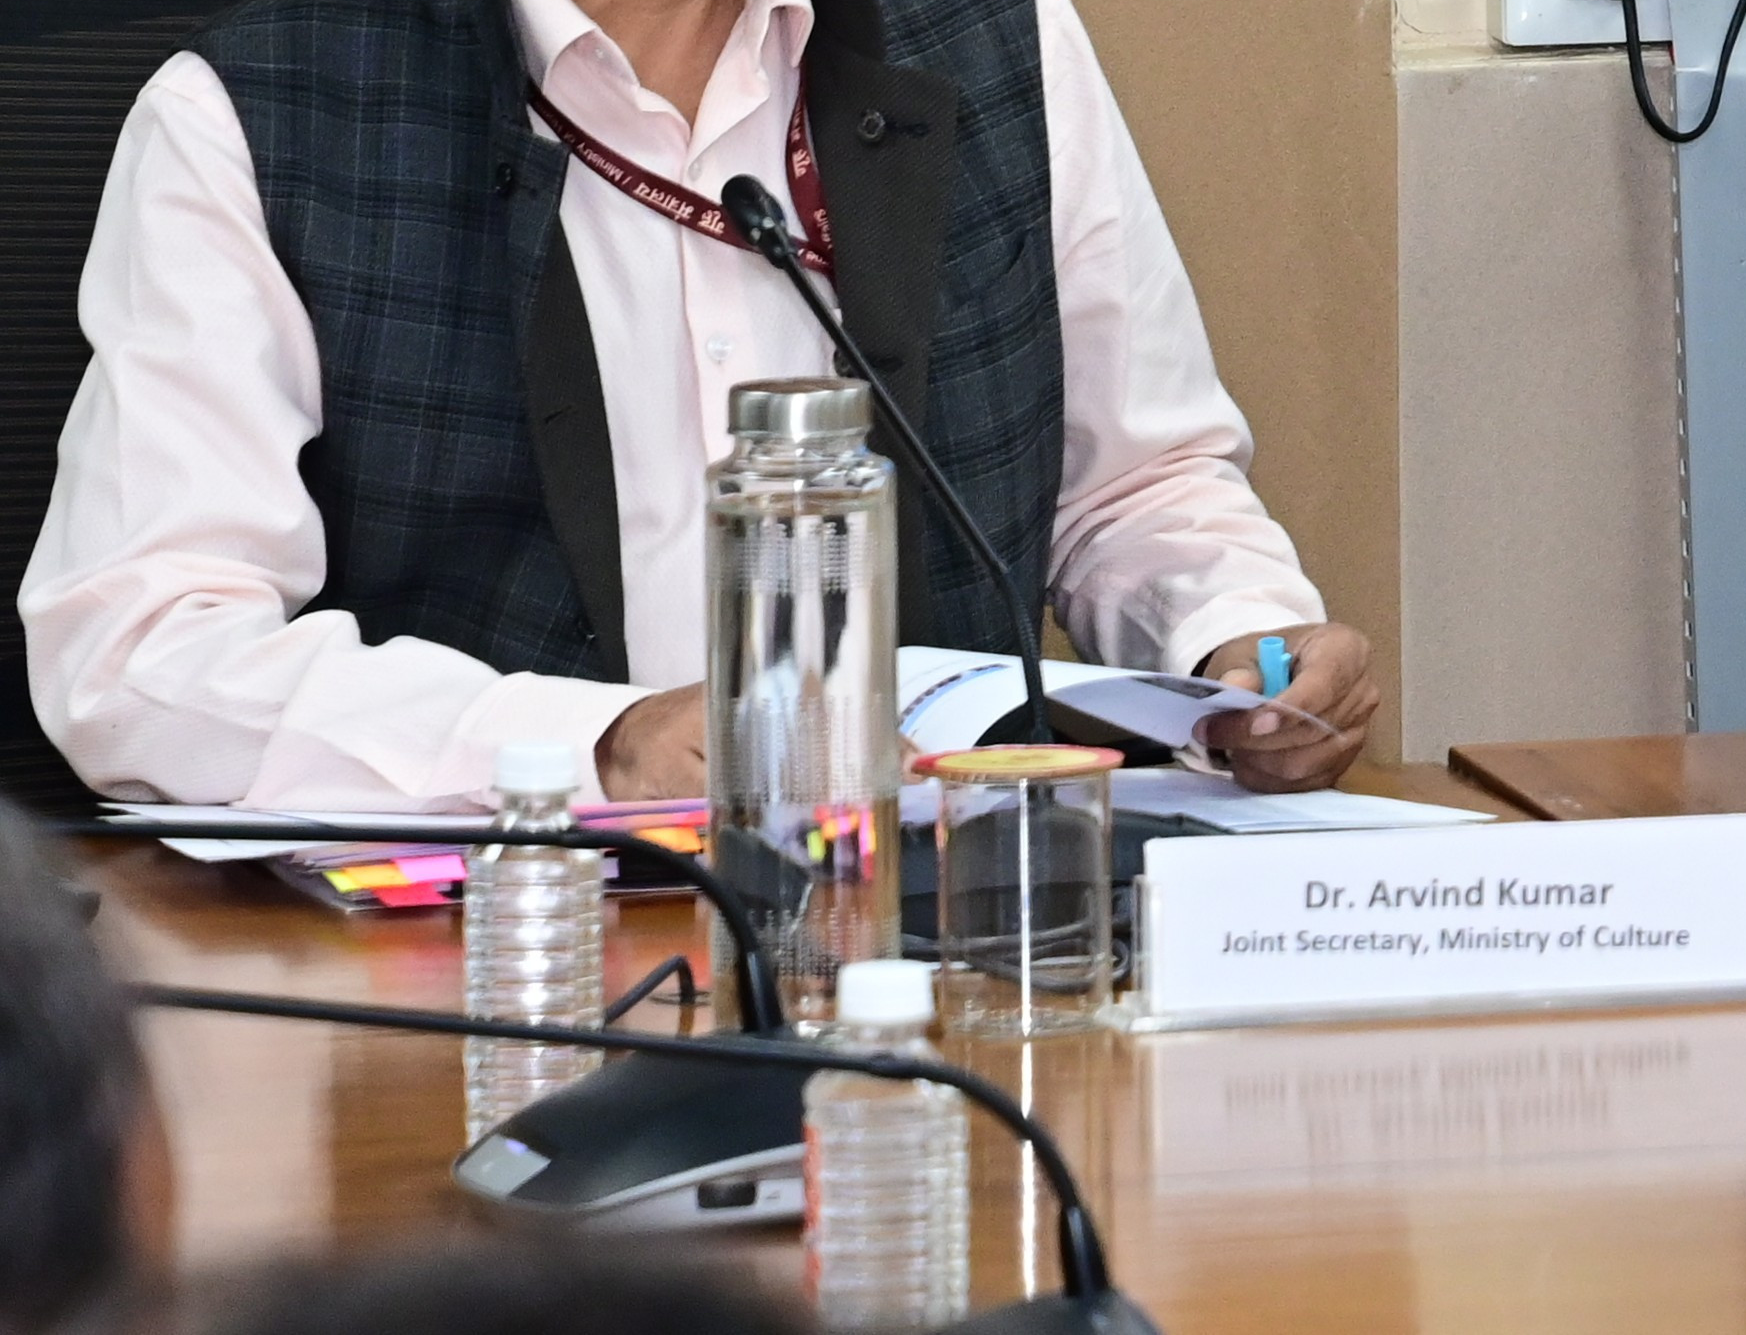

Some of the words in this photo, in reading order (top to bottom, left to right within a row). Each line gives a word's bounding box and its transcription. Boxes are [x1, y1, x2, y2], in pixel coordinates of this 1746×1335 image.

[575, 142, 625, 181] Ministry
[1304, 880, 1355, 910] Dr.
[1367, 877, 1485, 909] Arvind
[1498, 878, 1614, 907] Kumar
[1221, 930, 1286, 954] Joint
[1295, 929, 1430, 957] Secretary,
[1438, 928, 1551, 955] Ministry
[1558, 924, 1586, 948] of
[1592, 924, 1690, 948] Culture
